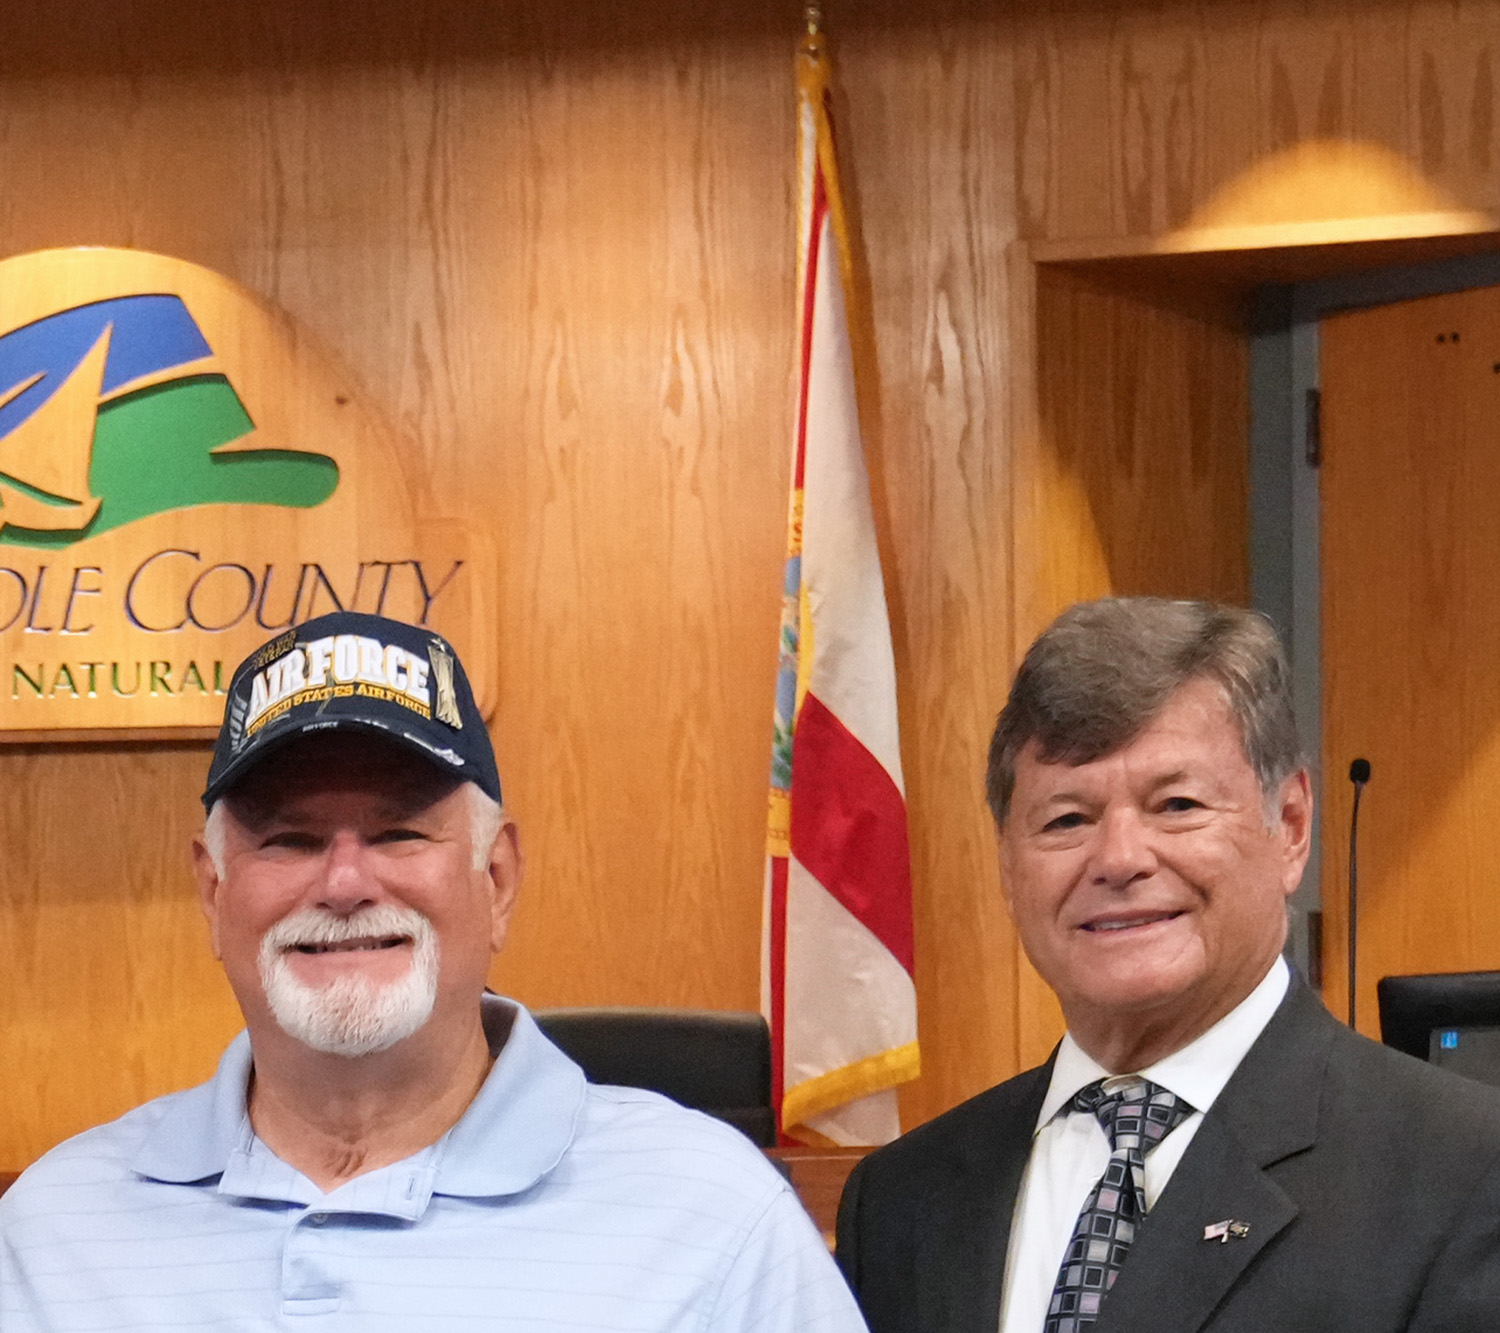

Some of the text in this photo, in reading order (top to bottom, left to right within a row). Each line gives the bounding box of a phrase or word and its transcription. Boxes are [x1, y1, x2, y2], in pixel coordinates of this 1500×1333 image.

[123, 548, 465, 632] COUNTY
[11, 660, 231, 700] NATURAL
[245, 648, 306, 731] AIR
[305, 634, 431, 706] FORCE
[247, 700, 292, 738] UNITED
[293, 685, 355, 706] STATES
[356, 683, 386, 700] AIR
[385, 691, 431, 720] FORCE
